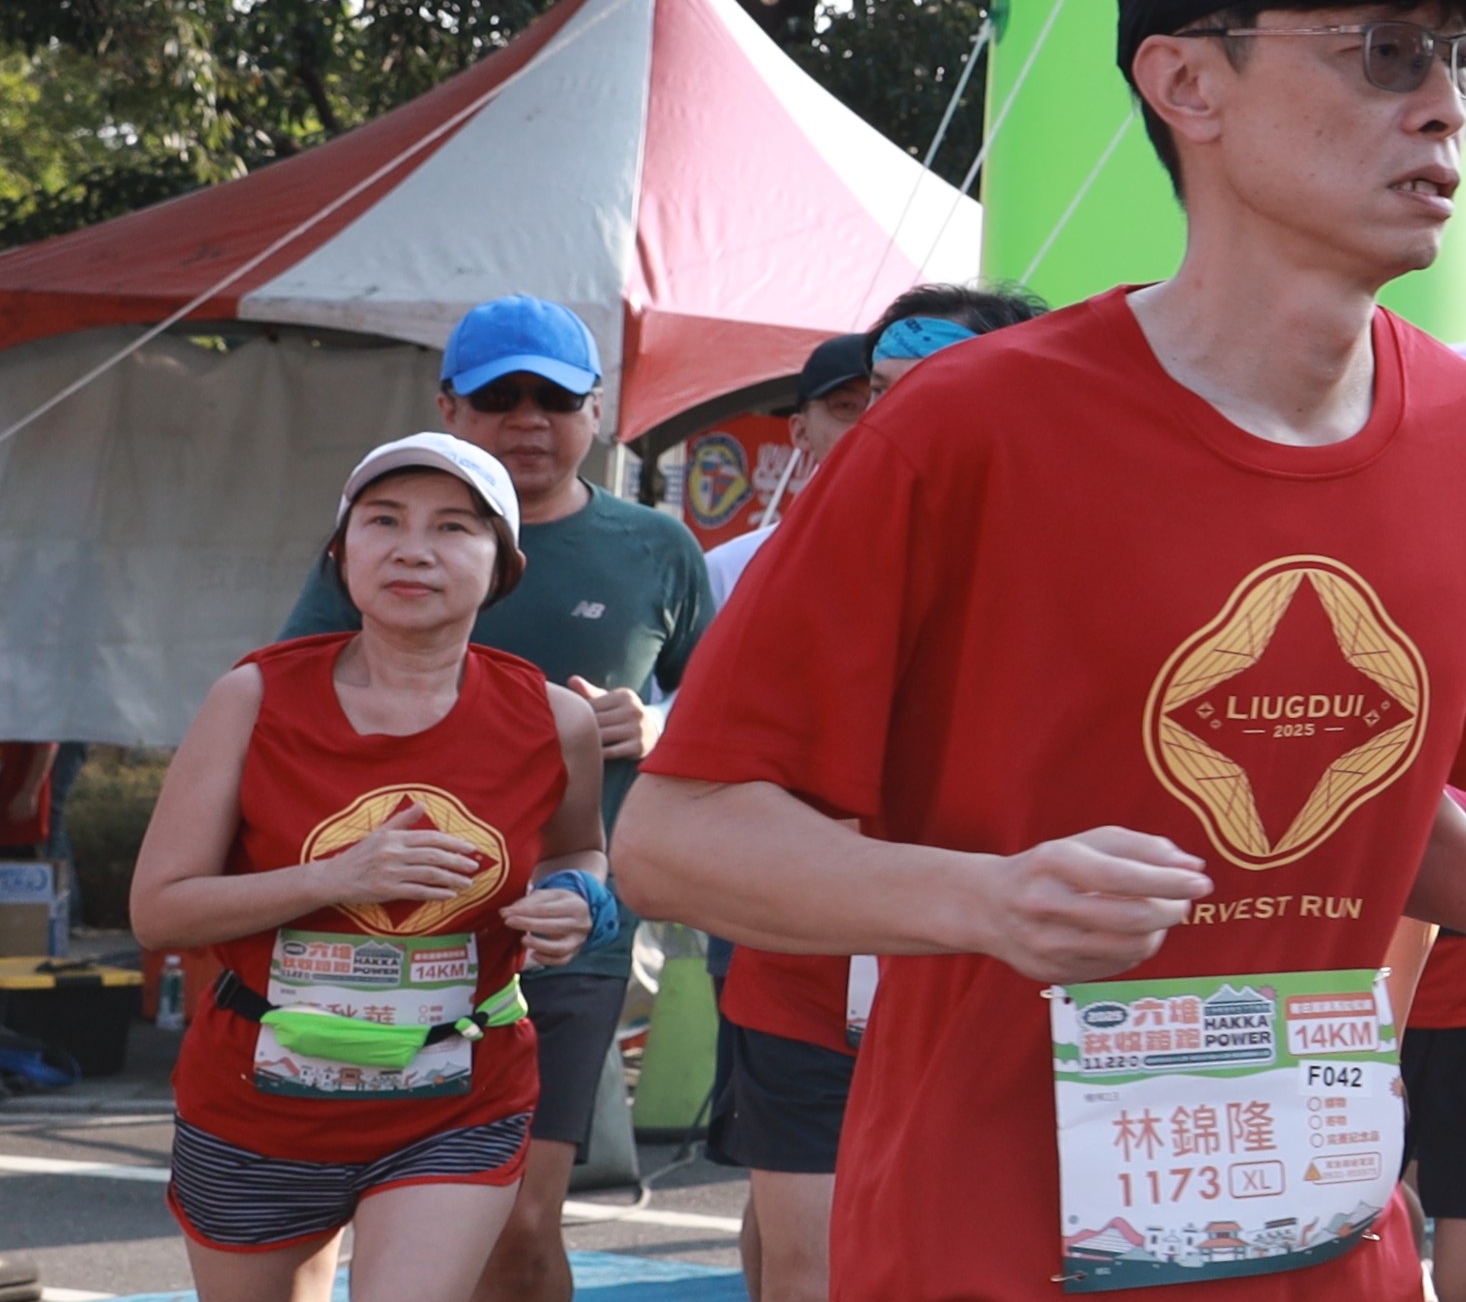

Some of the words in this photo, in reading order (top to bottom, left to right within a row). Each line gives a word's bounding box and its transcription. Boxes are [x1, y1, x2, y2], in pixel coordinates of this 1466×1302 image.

[1226, 694, 1365, 720] LIUGDUI
[1273, 723, 1315, 738] 2025
[1300, 895, 1363, 919] RUN
[354, 957, 399, 966] HAKKA
[354, 966, 399, 975] POWER
[415, 963, 465, 980] 14KM
[1132, 997, 1201, 1027] 六堆
[1204, 1015, 1270, 1031] HAKKA
[1204, 1031, 1272, 1047] POWER
[1295, 1022, 1373, 1050] 14KM
[1308, 1065, 1363, 1088] F042
[1112, 1101, 1278, 1163] 林錦隆
[1117, 1167, 1221, 1207] 1173
[1242, 1168, 1273, 1191] XL
